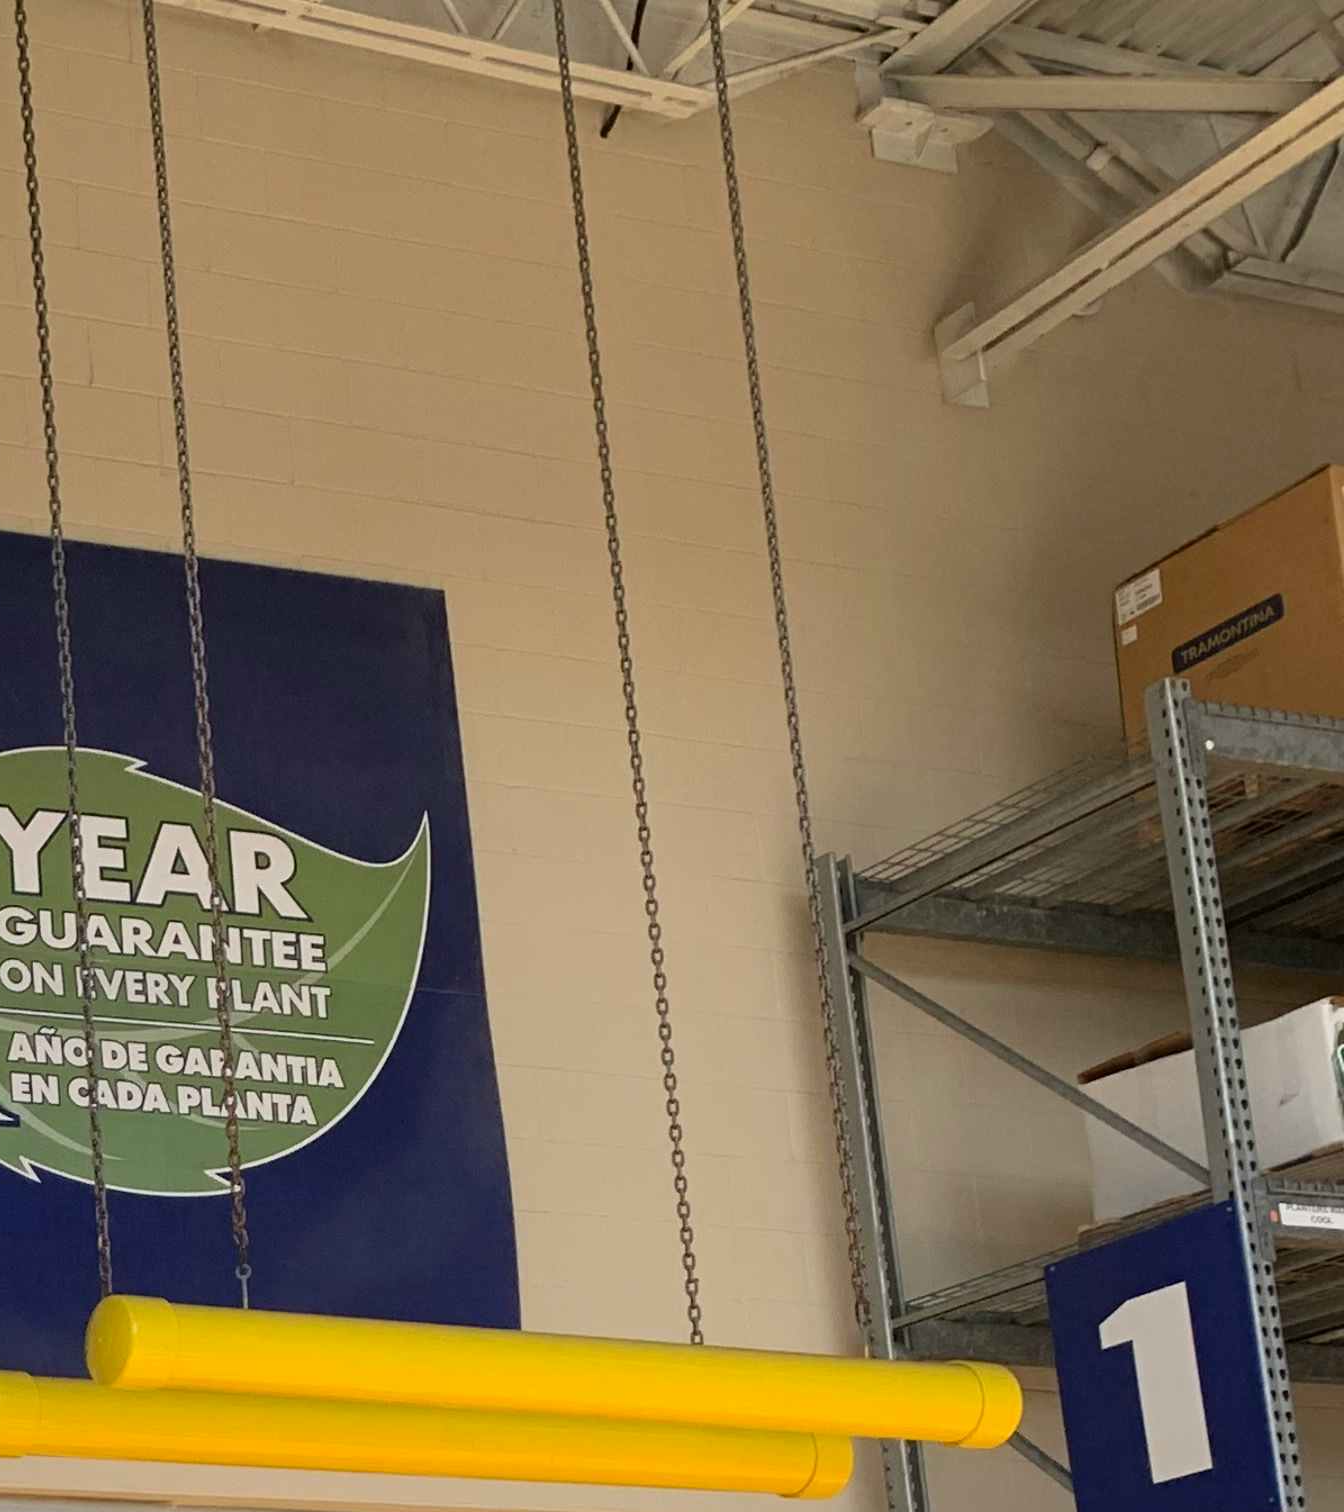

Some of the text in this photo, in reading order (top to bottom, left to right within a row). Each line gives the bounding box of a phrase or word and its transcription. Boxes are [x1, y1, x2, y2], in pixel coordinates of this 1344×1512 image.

[1180, 604, 1275, 665] TRAMONTINA
[8, 1027, 345, 1090] AÑO DE GARANTIA
[11, 1072, 318, 1127] EN CADA PLANTA
[1098, 1281, 1214, 1485] 1
